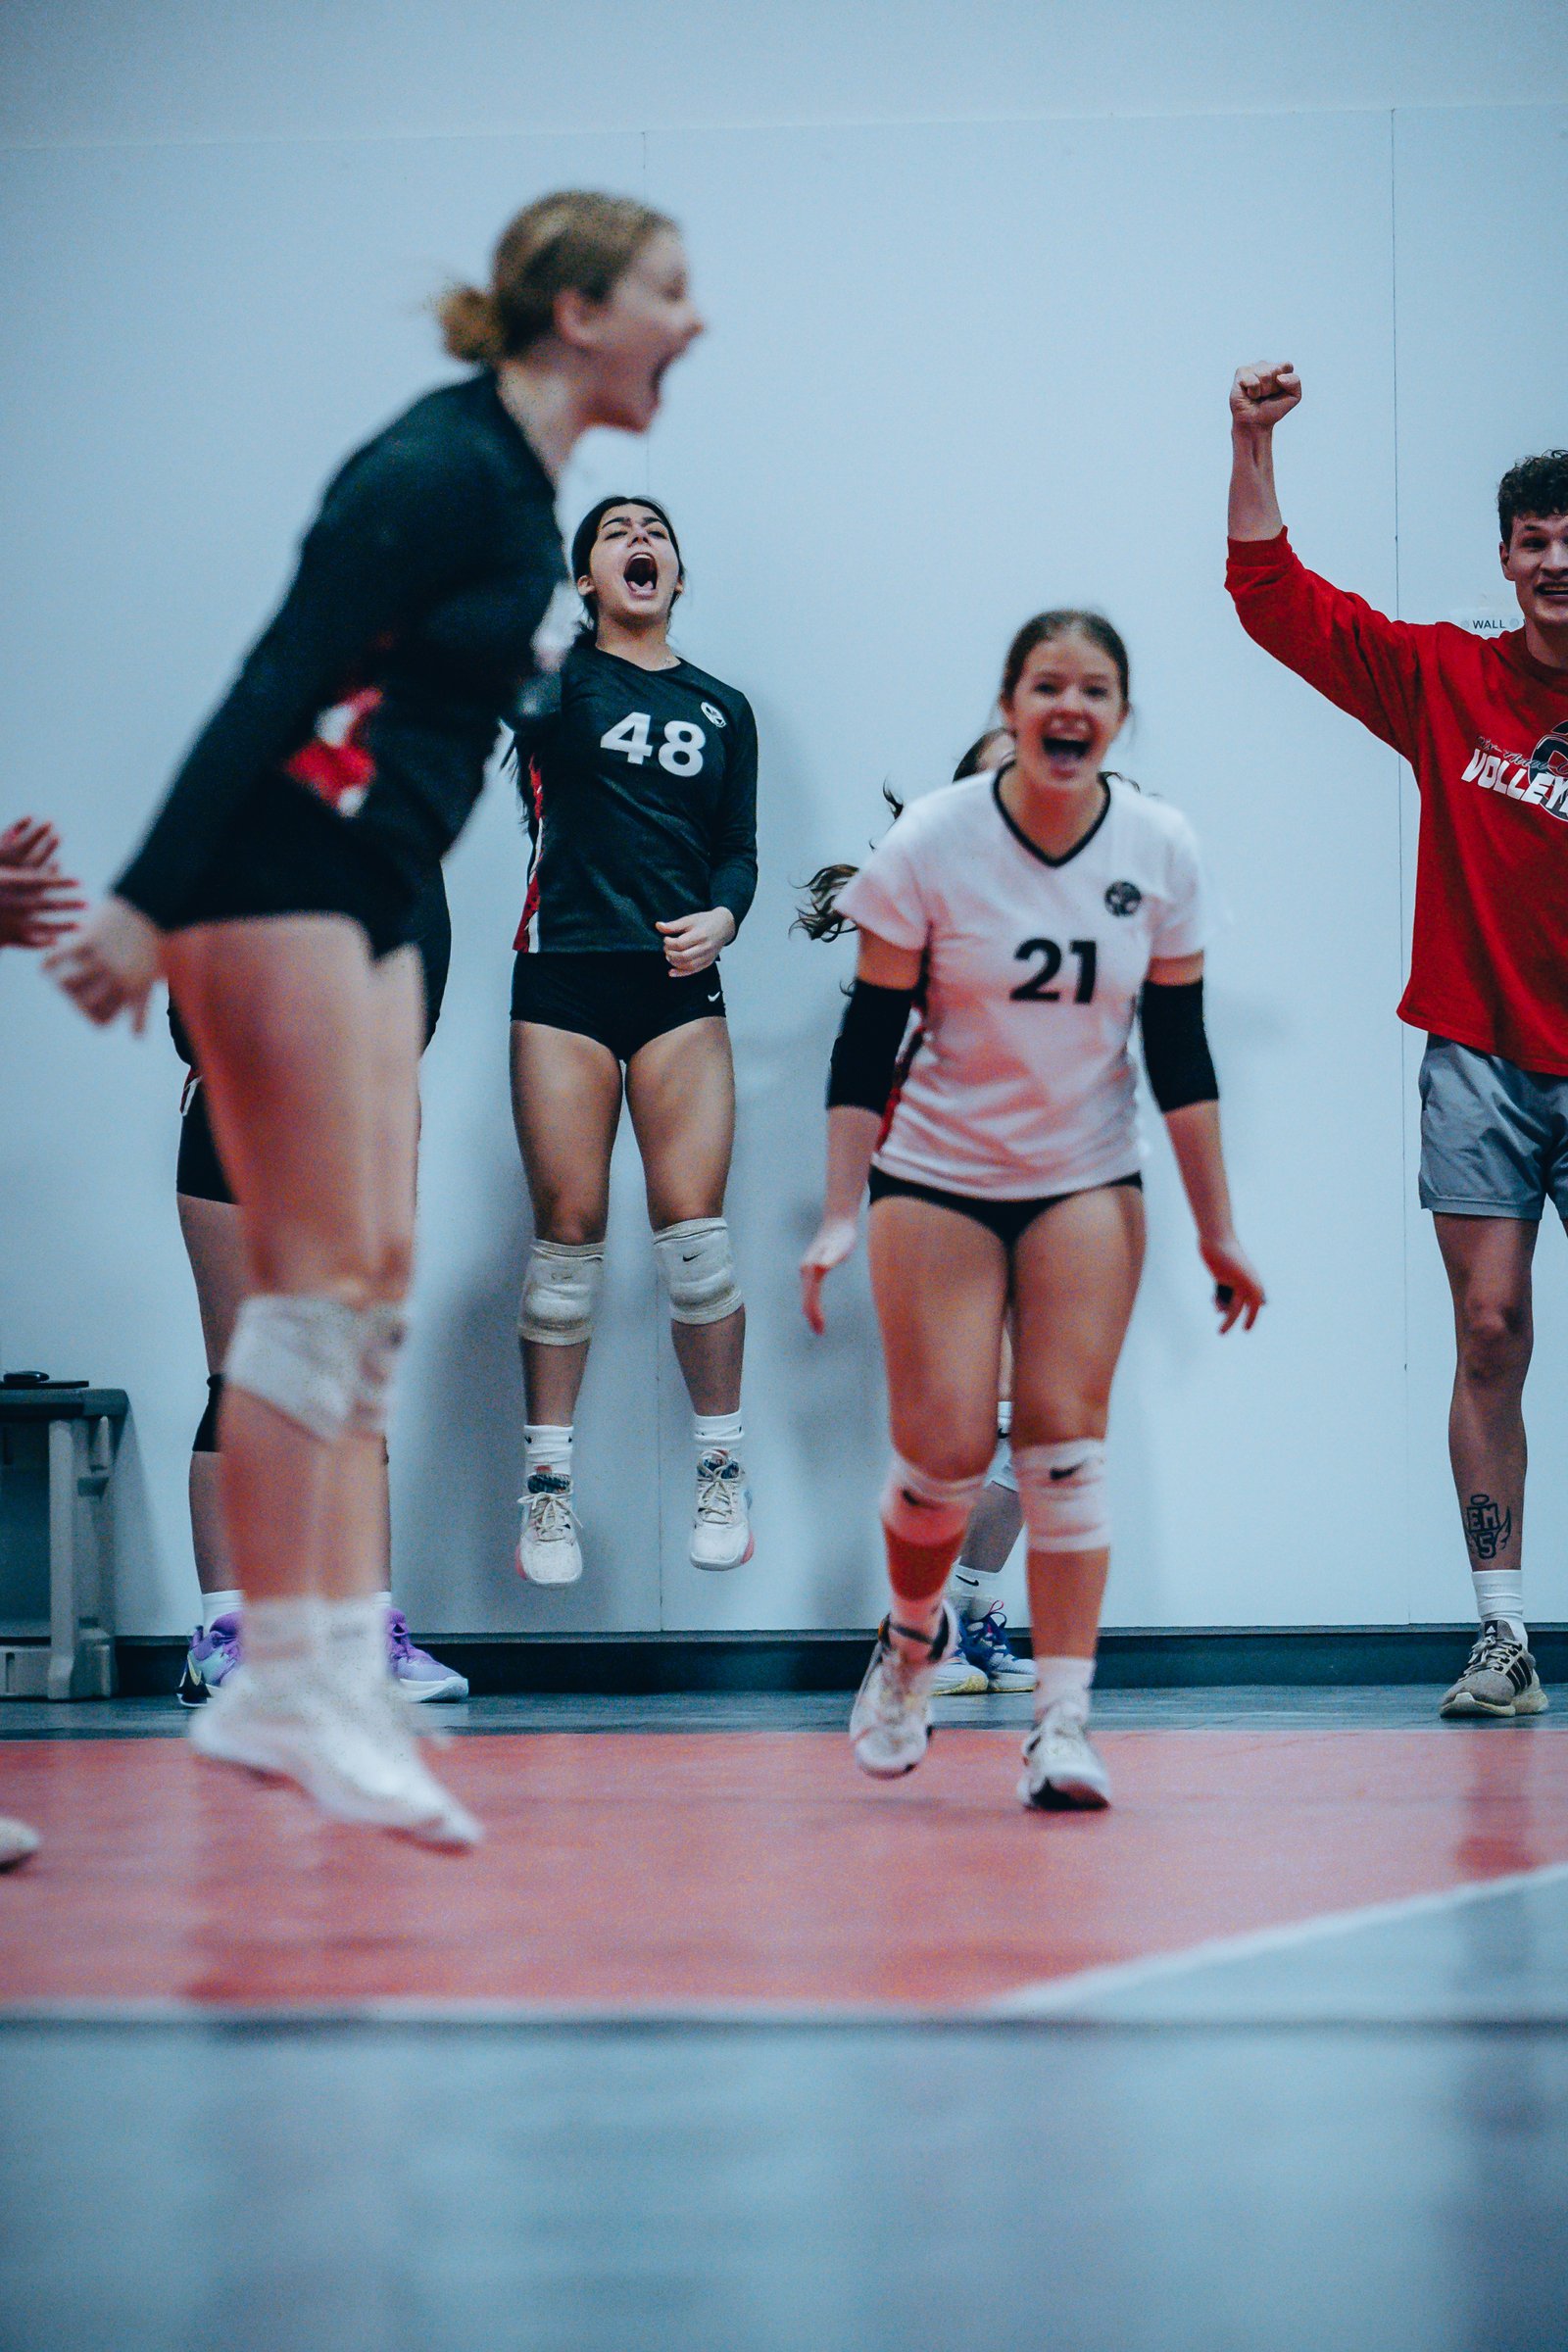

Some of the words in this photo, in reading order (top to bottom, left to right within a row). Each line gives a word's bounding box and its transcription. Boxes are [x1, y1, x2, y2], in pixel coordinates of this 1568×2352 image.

[1472, 619, 1506, 629] WALL
[600, 711, 706, 777] 48
[1461, 748, 1568, 816] VOLLEY
[1009, 938, 1097, 1004] 21
